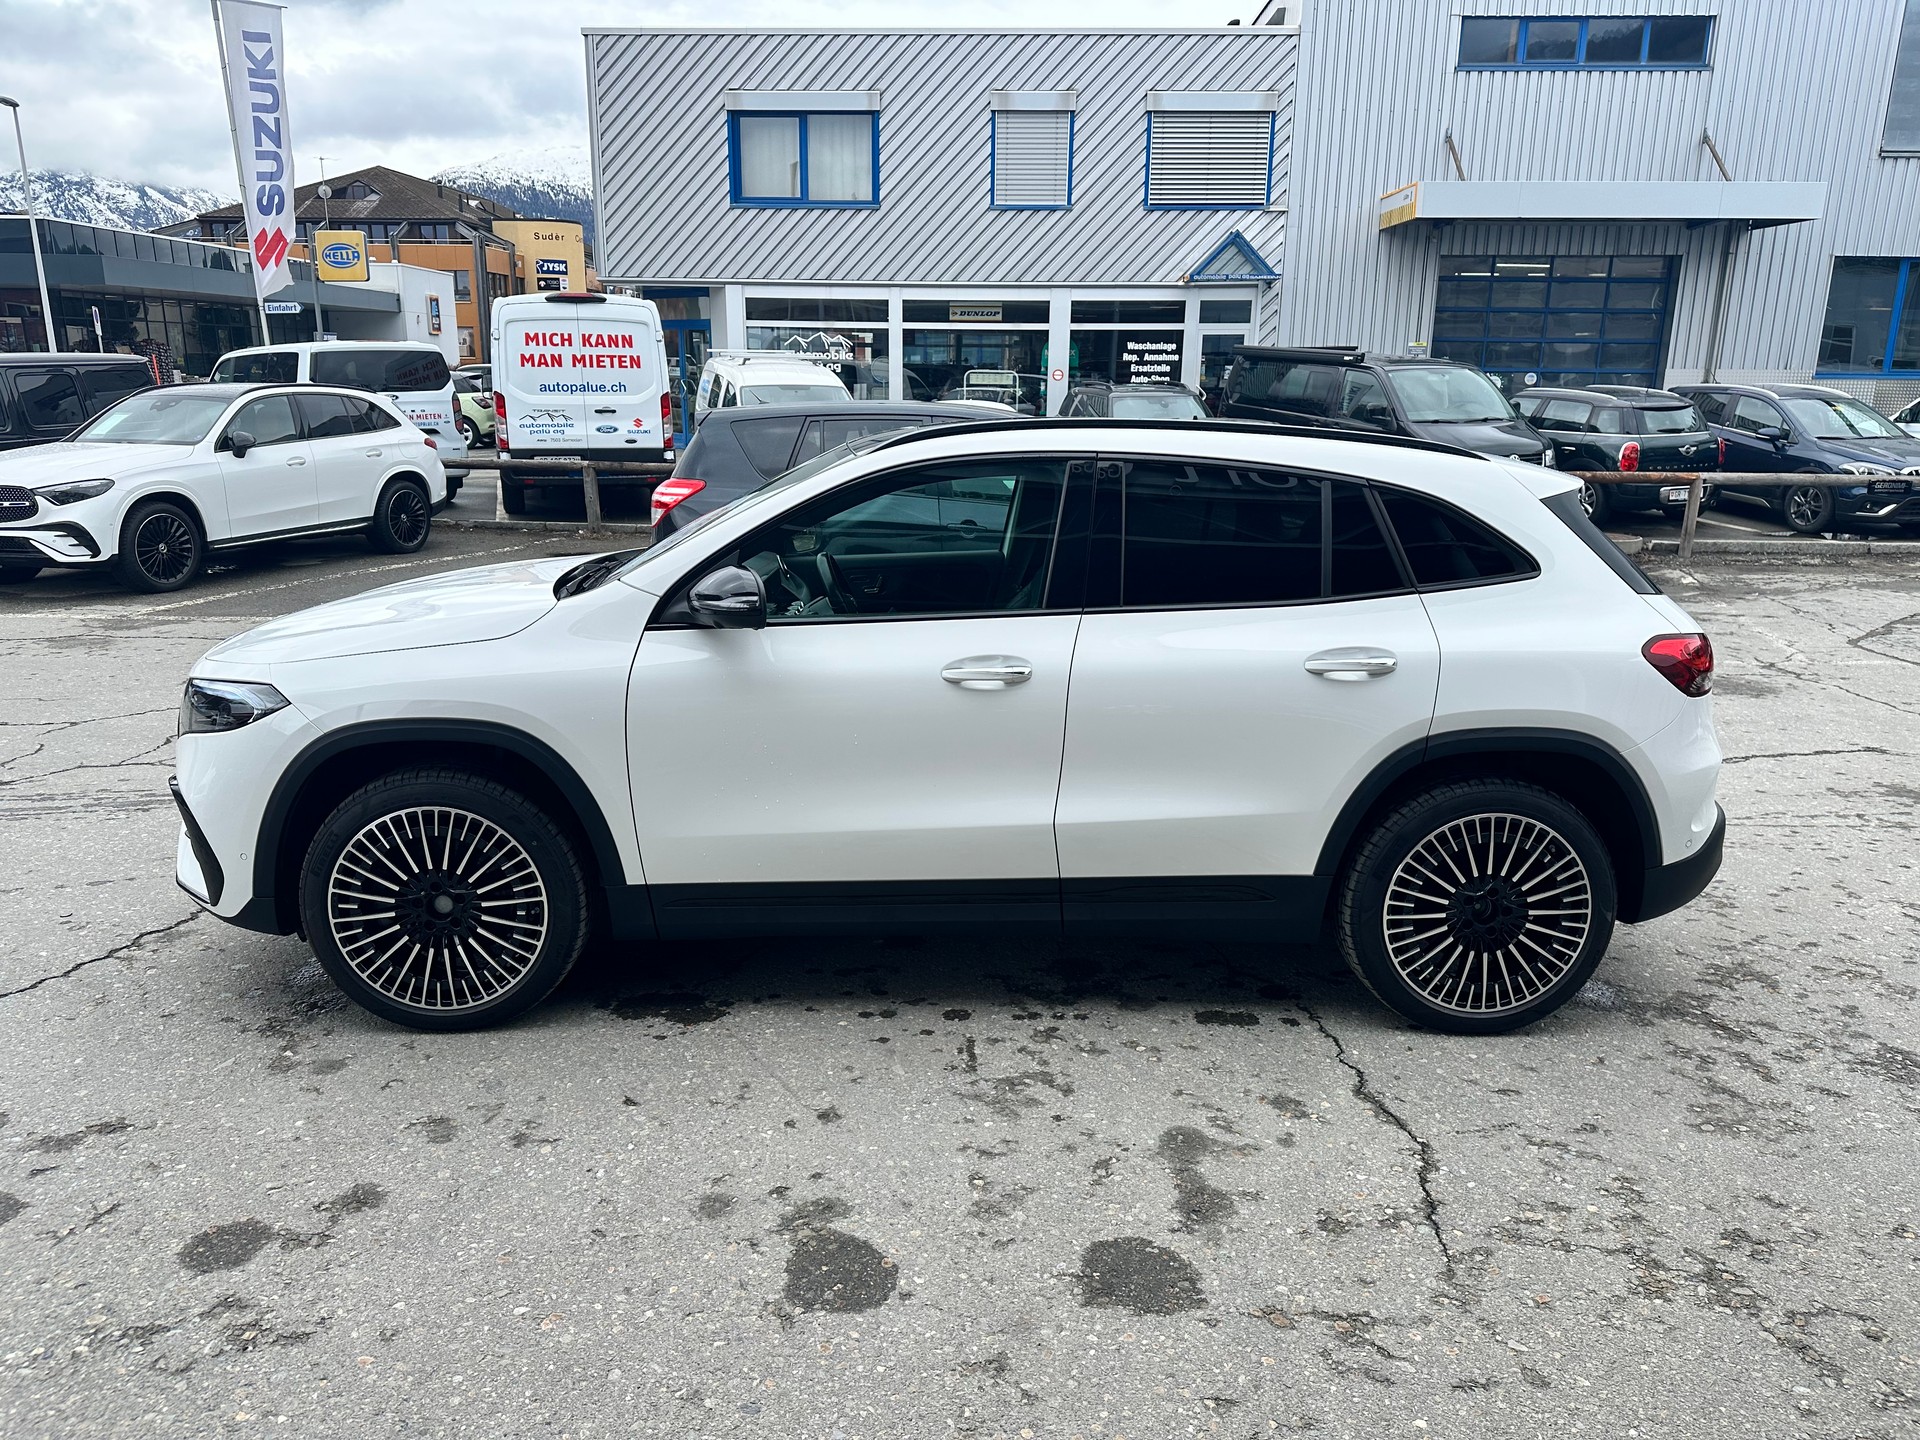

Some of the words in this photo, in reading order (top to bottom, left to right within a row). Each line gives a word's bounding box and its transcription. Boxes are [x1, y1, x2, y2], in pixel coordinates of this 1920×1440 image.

[241, 29, 285, 216] SUZUKI
[533, 231, 565, 241] Sudèr
[325, 250, 361, 262] HELLA
[542, 262, 567, 271] JYSK
[267, 304, 297, 312] Einfahrt
[524, 332, 573, 347] MICH
[581, 333, 633, 348] KANN
[1127, 341, 1177, 352] Waschanlage
[520, 353, 563, 368] MAN
[571, 353, 641, 369] MIETEN
[1122, 352, 1140, 363] Rep.
[1143, 352, 1180, 361] Annahme
[1130, 363, 1171, 372] Ersatzteile
[539, 381, 627, 395] autopalue.ch
